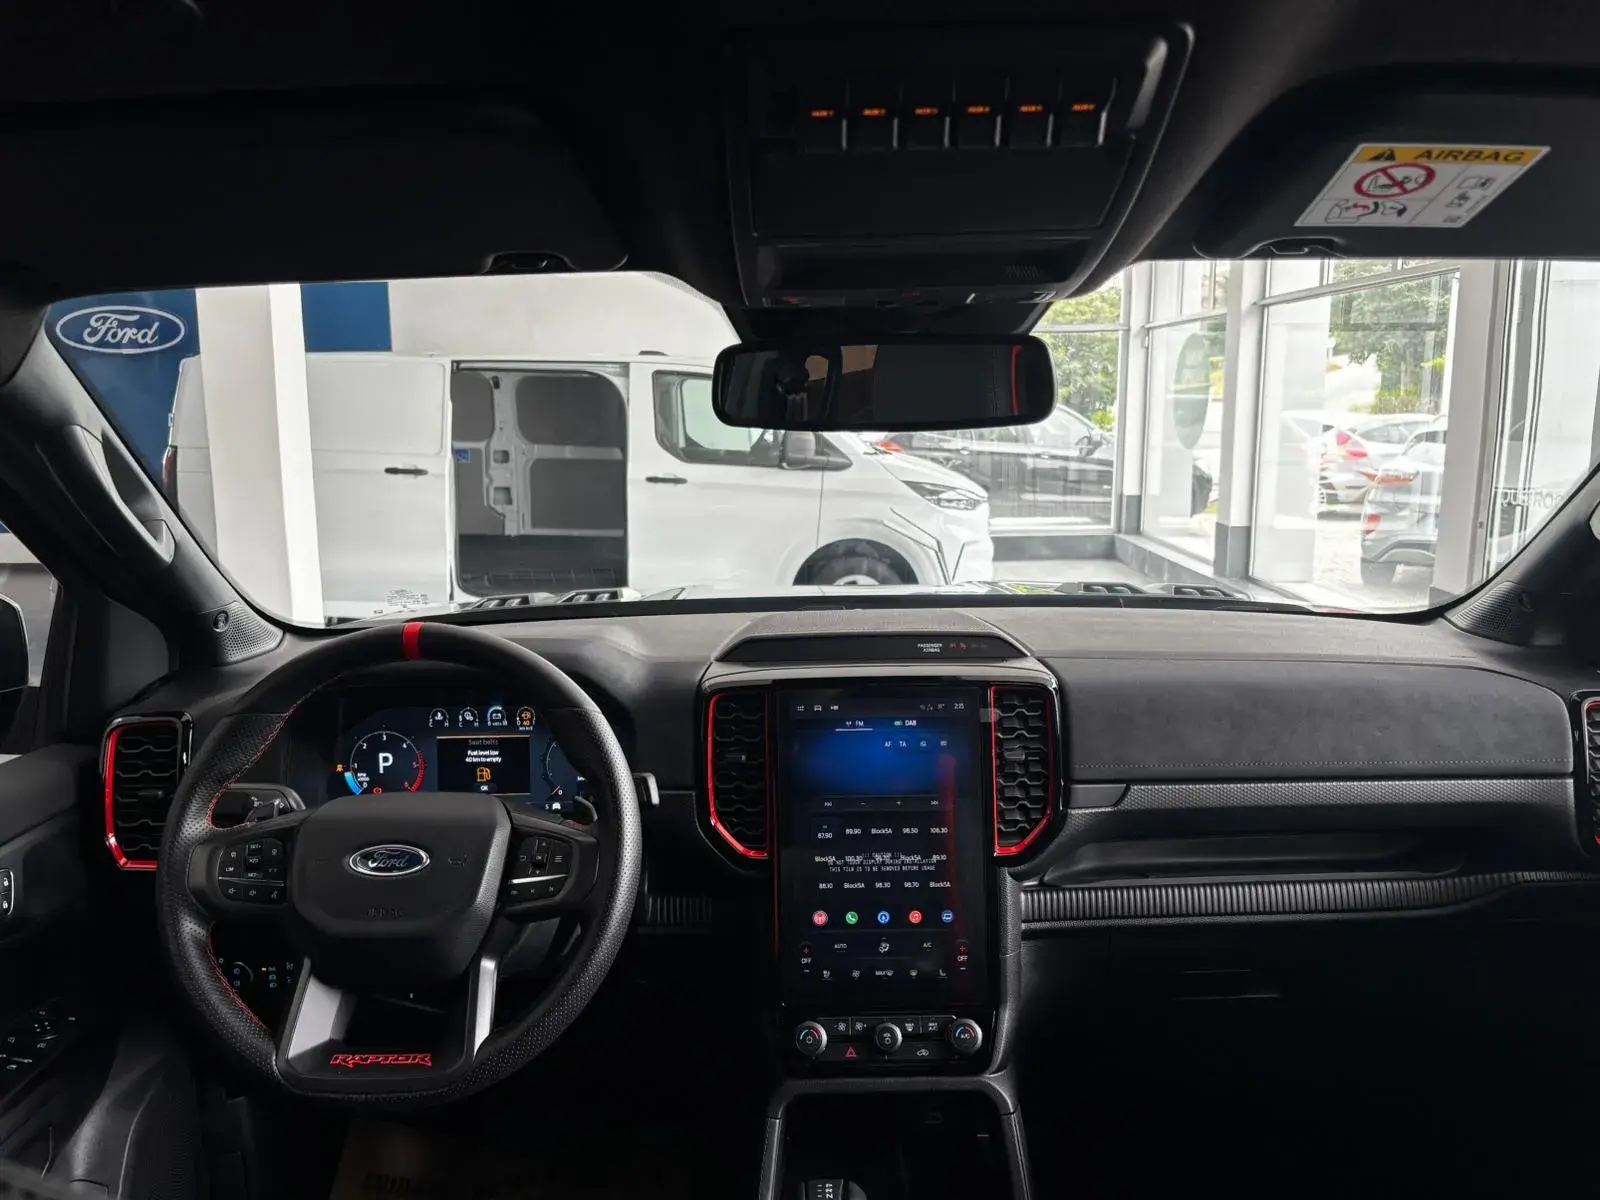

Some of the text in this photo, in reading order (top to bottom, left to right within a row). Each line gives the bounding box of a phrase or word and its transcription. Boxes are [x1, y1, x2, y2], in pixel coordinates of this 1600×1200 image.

[1414, 149, 1525, 162] AIRBAG
[82, 312, 160, 344] Ford
[855, 719, 864, 727] FM
[905, 719, 917, 727] DAB
[884, 740, 892, 748] AF
[899, 740, 907, 748] TA
[378, 752, 394, 774] P
[368, 849, 410, 870] Ford
[329, 1053, 433, 1068] RAPTOR
